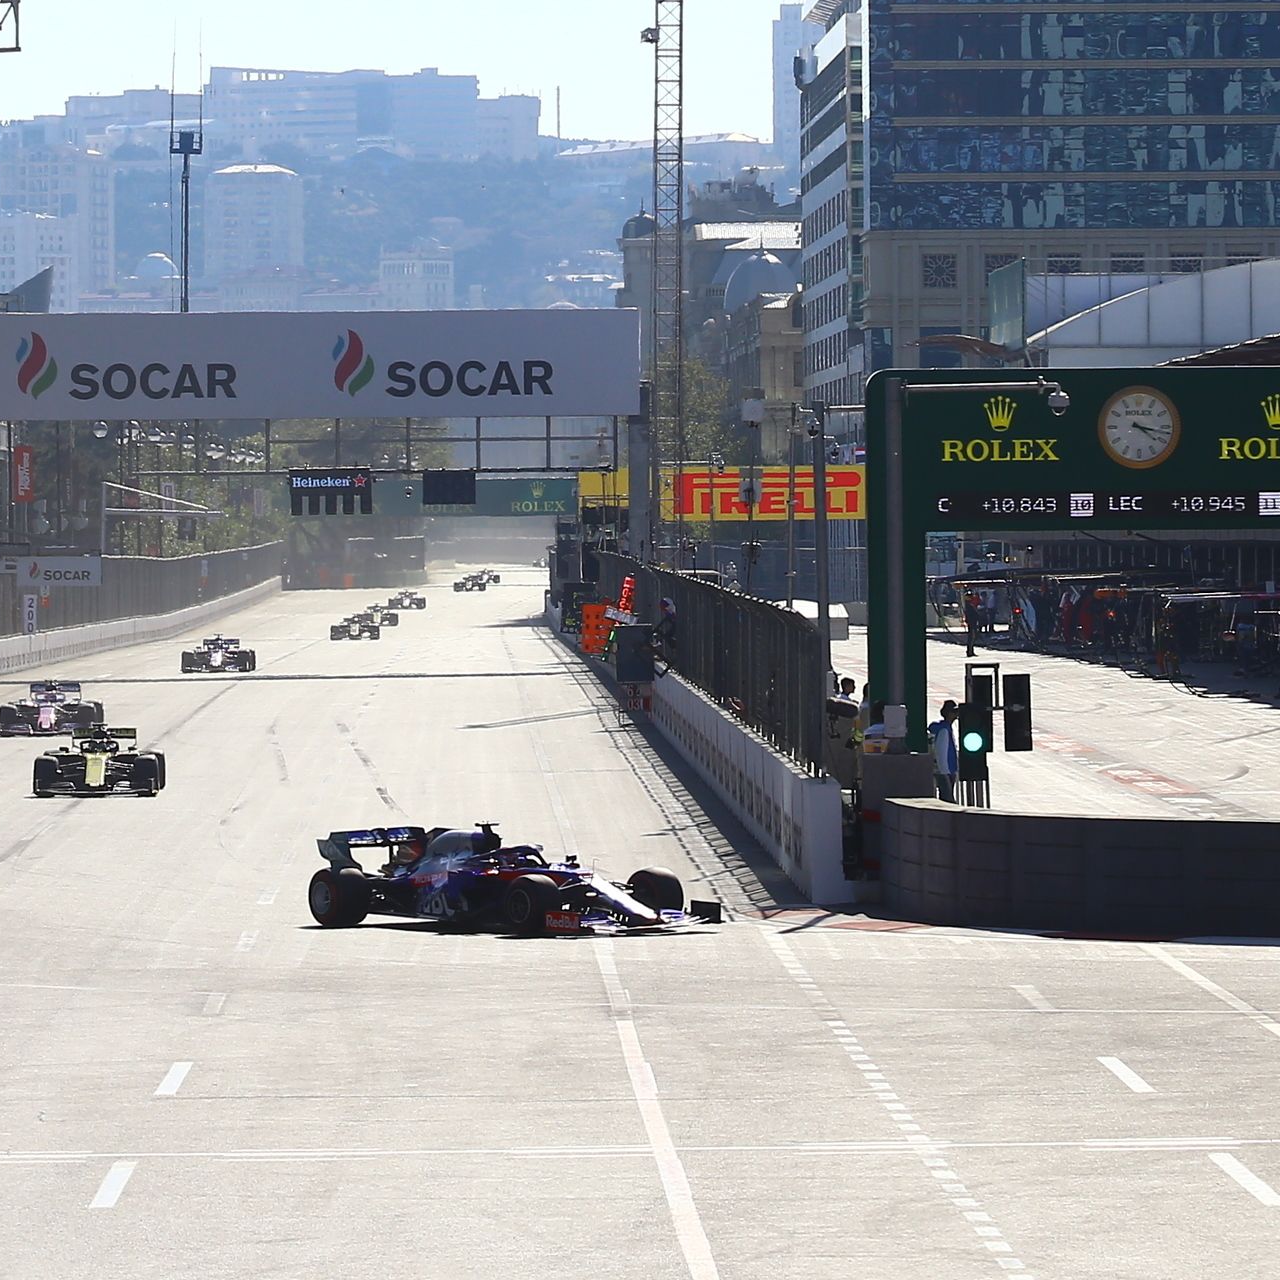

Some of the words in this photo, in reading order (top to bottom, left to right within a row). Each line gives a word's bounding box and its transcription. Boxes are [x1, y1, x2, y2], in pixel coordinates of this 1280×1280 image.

[69, 363, 237, 400] SOCAR
[385, 360, 554, 398] SOCAR
[941, 439, 1060, 462] ROLEX
[291, 476, 350, 488] Heineken
[673, 471, 861, 515] PIRELLI
[511, 501, 566, 512] ROLEX
[982, 498, 1057, 513] +10.843
[1108, 496, 1143, 510] LEC
[1172, 497, 1246, 512] +10.945
[43, 570, 91, 581] SOCAR
